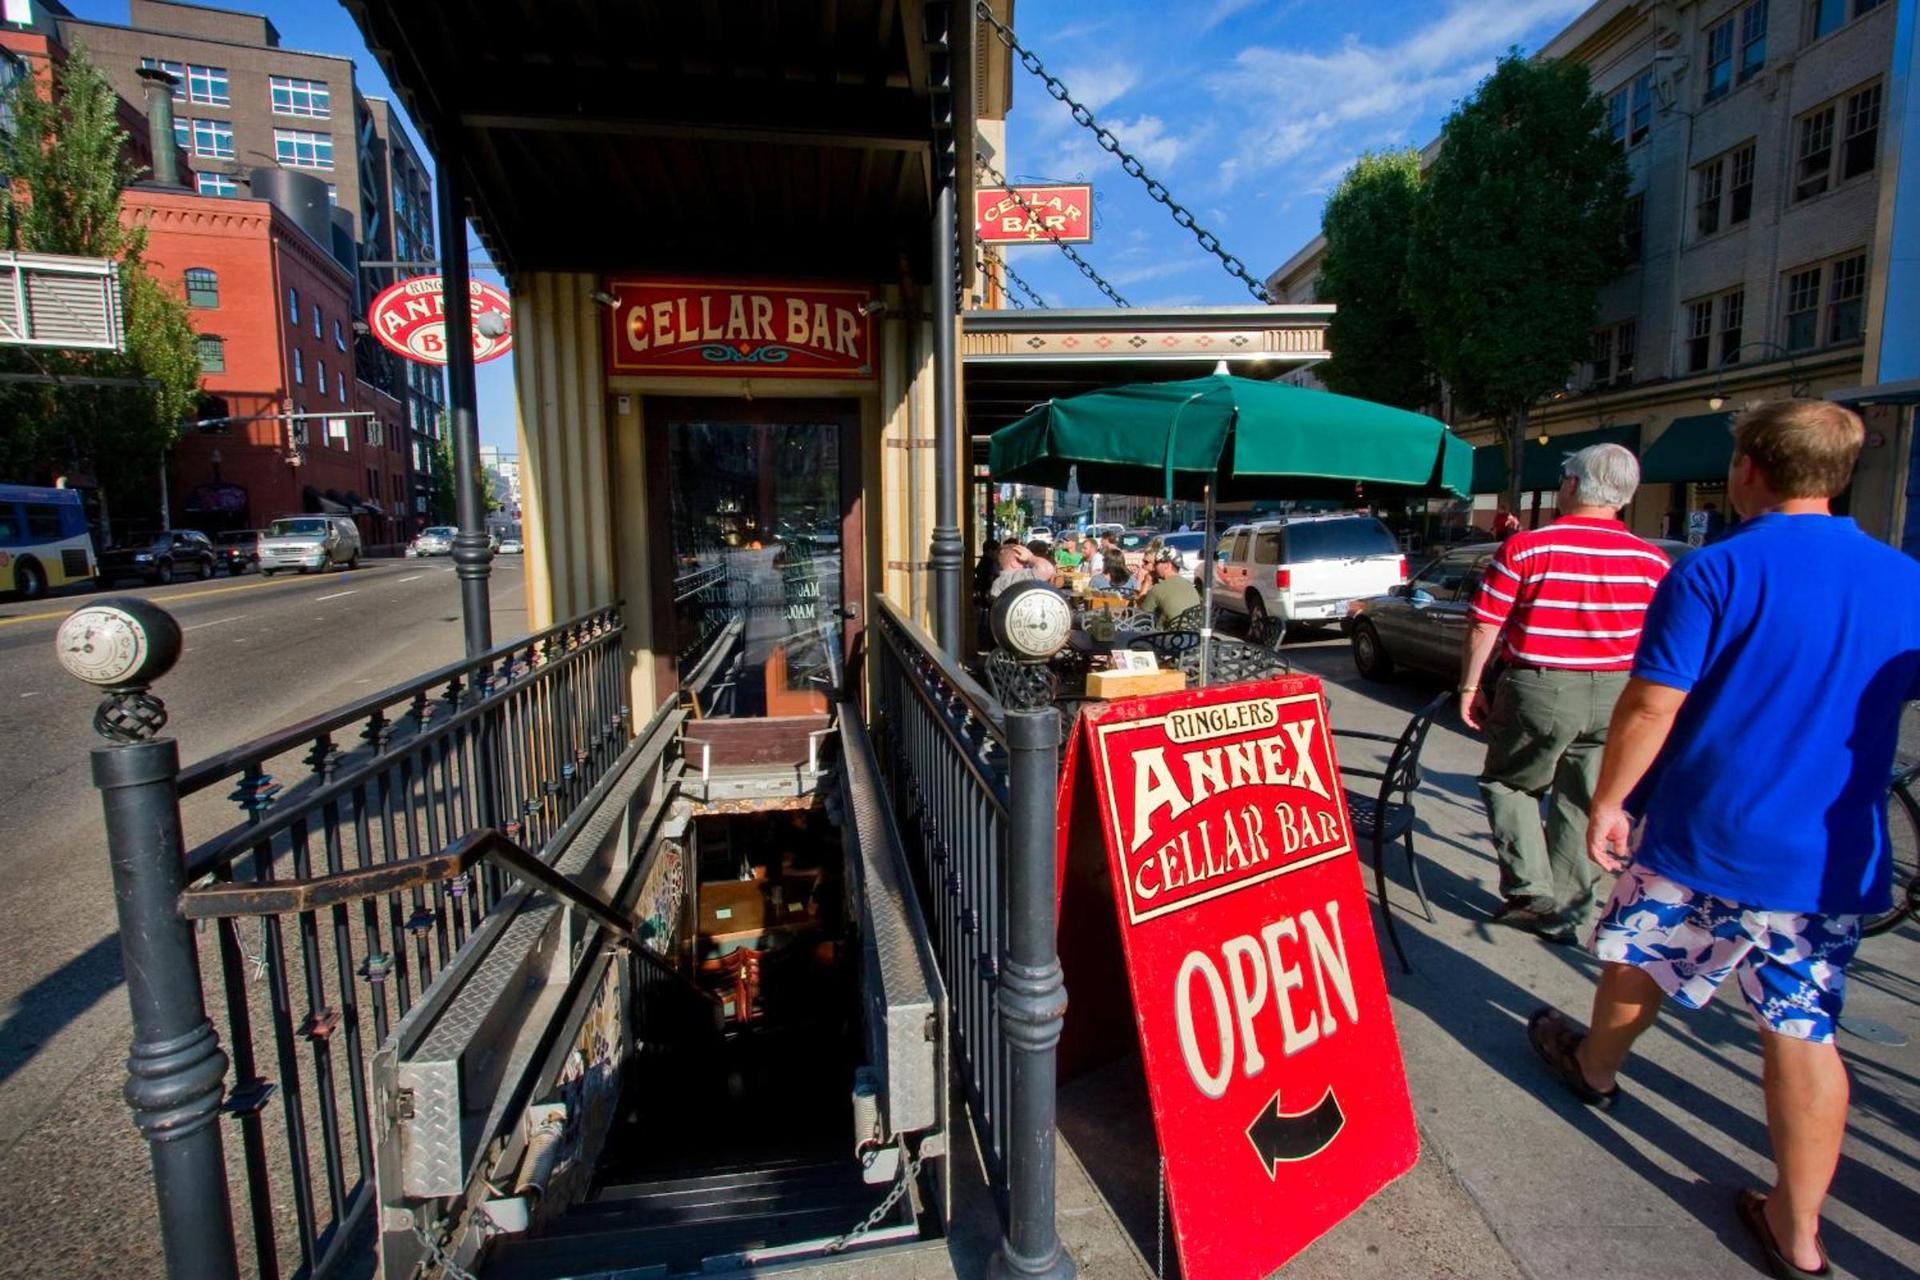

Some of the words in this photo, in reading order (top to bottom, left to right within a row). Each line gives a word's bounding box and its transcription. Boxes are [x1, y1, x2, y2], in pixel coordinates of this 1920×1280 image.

[983, 192, 1082, 222] CELLAR
[1001, 215, 1066, 232] BAR
[409, 278, 479, 294] RINGS
[626, 294, 777, 352] CELLAR
[785, 298, 859, 359] BAR
[1172, 700, 1276, 740] RINGLERS
[1131, 718, 1331, 854] ANNEX
[1134, 803, 1269, 900] CELLAR
[1274, 801, 1341, 855] BAR
[1174, 899, 1360, 1100] OPEN
